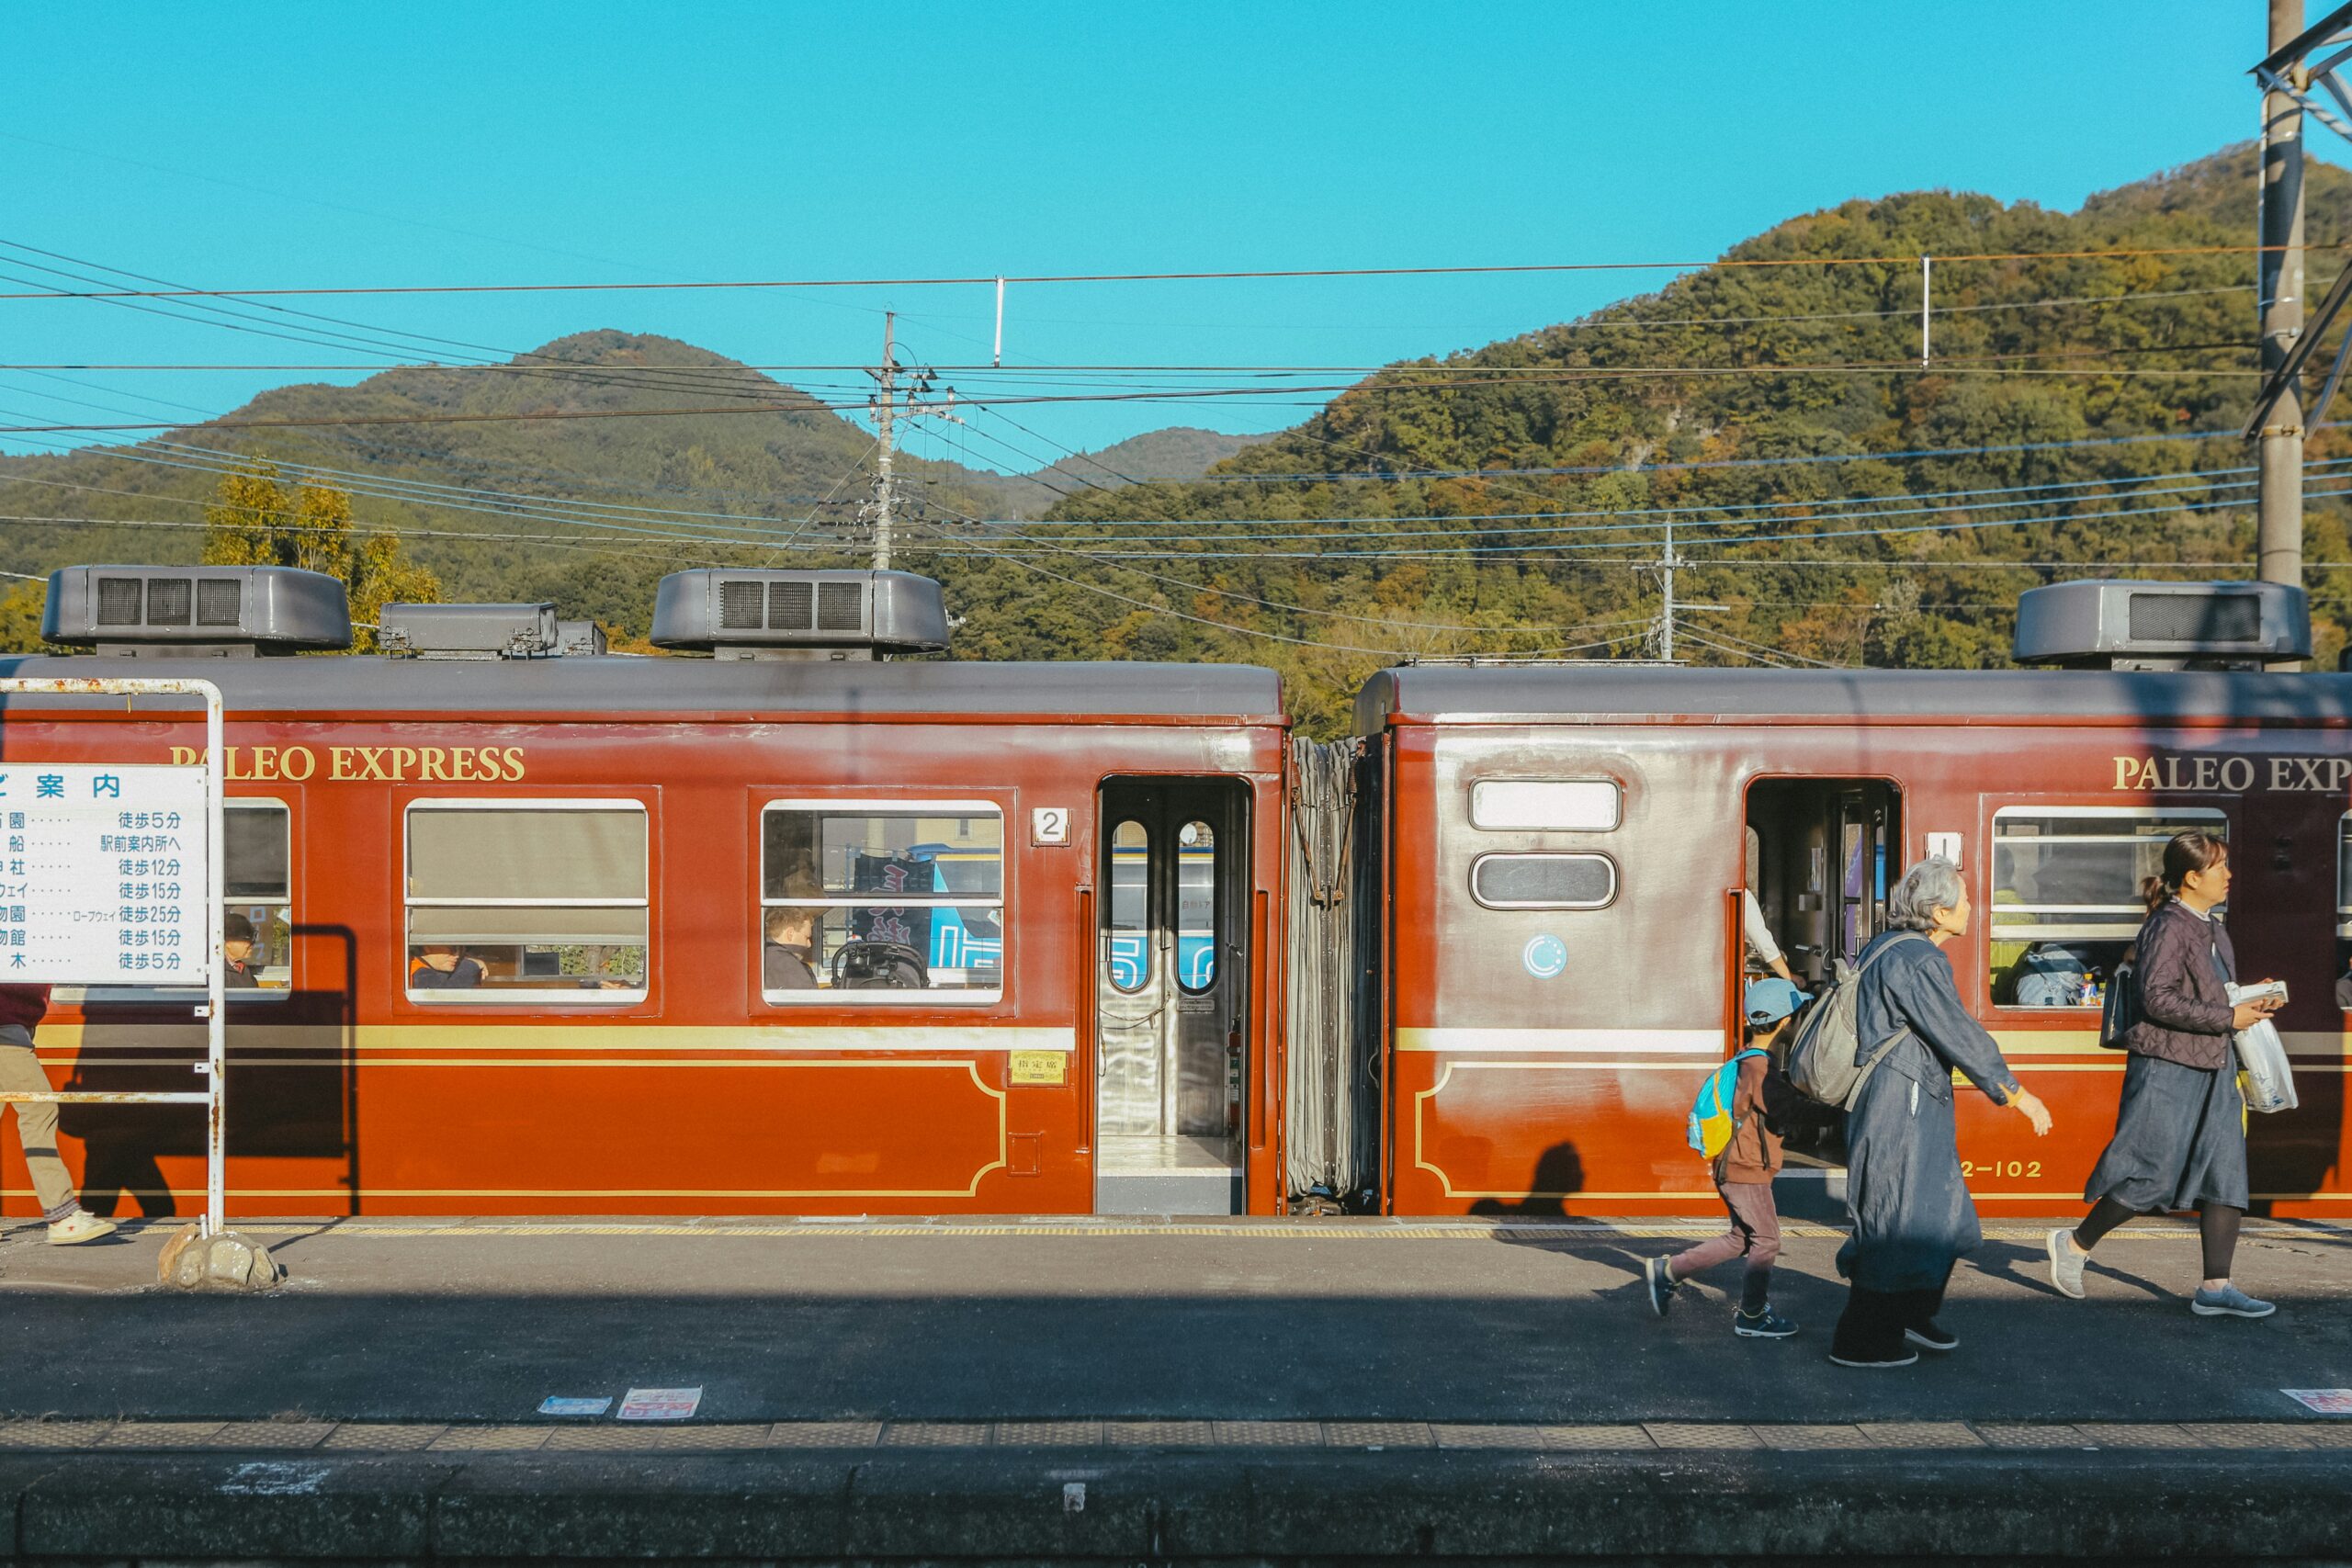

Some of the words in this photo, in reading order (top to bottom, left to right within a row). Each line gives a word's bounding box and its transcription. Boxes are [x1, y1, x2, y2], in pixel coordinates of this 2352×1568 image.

[169, 746, 315, 781] PLEO
[328, 746, 526, 781] EXPRESS
[2112, 756, 2256, 791] PALEO
[2267, 757, 2352, 792] EXP
[0, 812, 25, 829] 園
[119, 811, 181, 829] 徒歩5分
[1043, 811, 1059, 835] 2
[100, 835, 181, 852] 駅前案内所へ
[0, 859, 26, 875] 社
[119, 859, 181, 876] 徒歩12分
[119, 882, 181, 899] 徒歩15分
[119, 906, 181, 923] 徒歩25分
[119, 929, 181, 946] 徒歩15分
[119, 953, 181, 970] 徒歩5分
